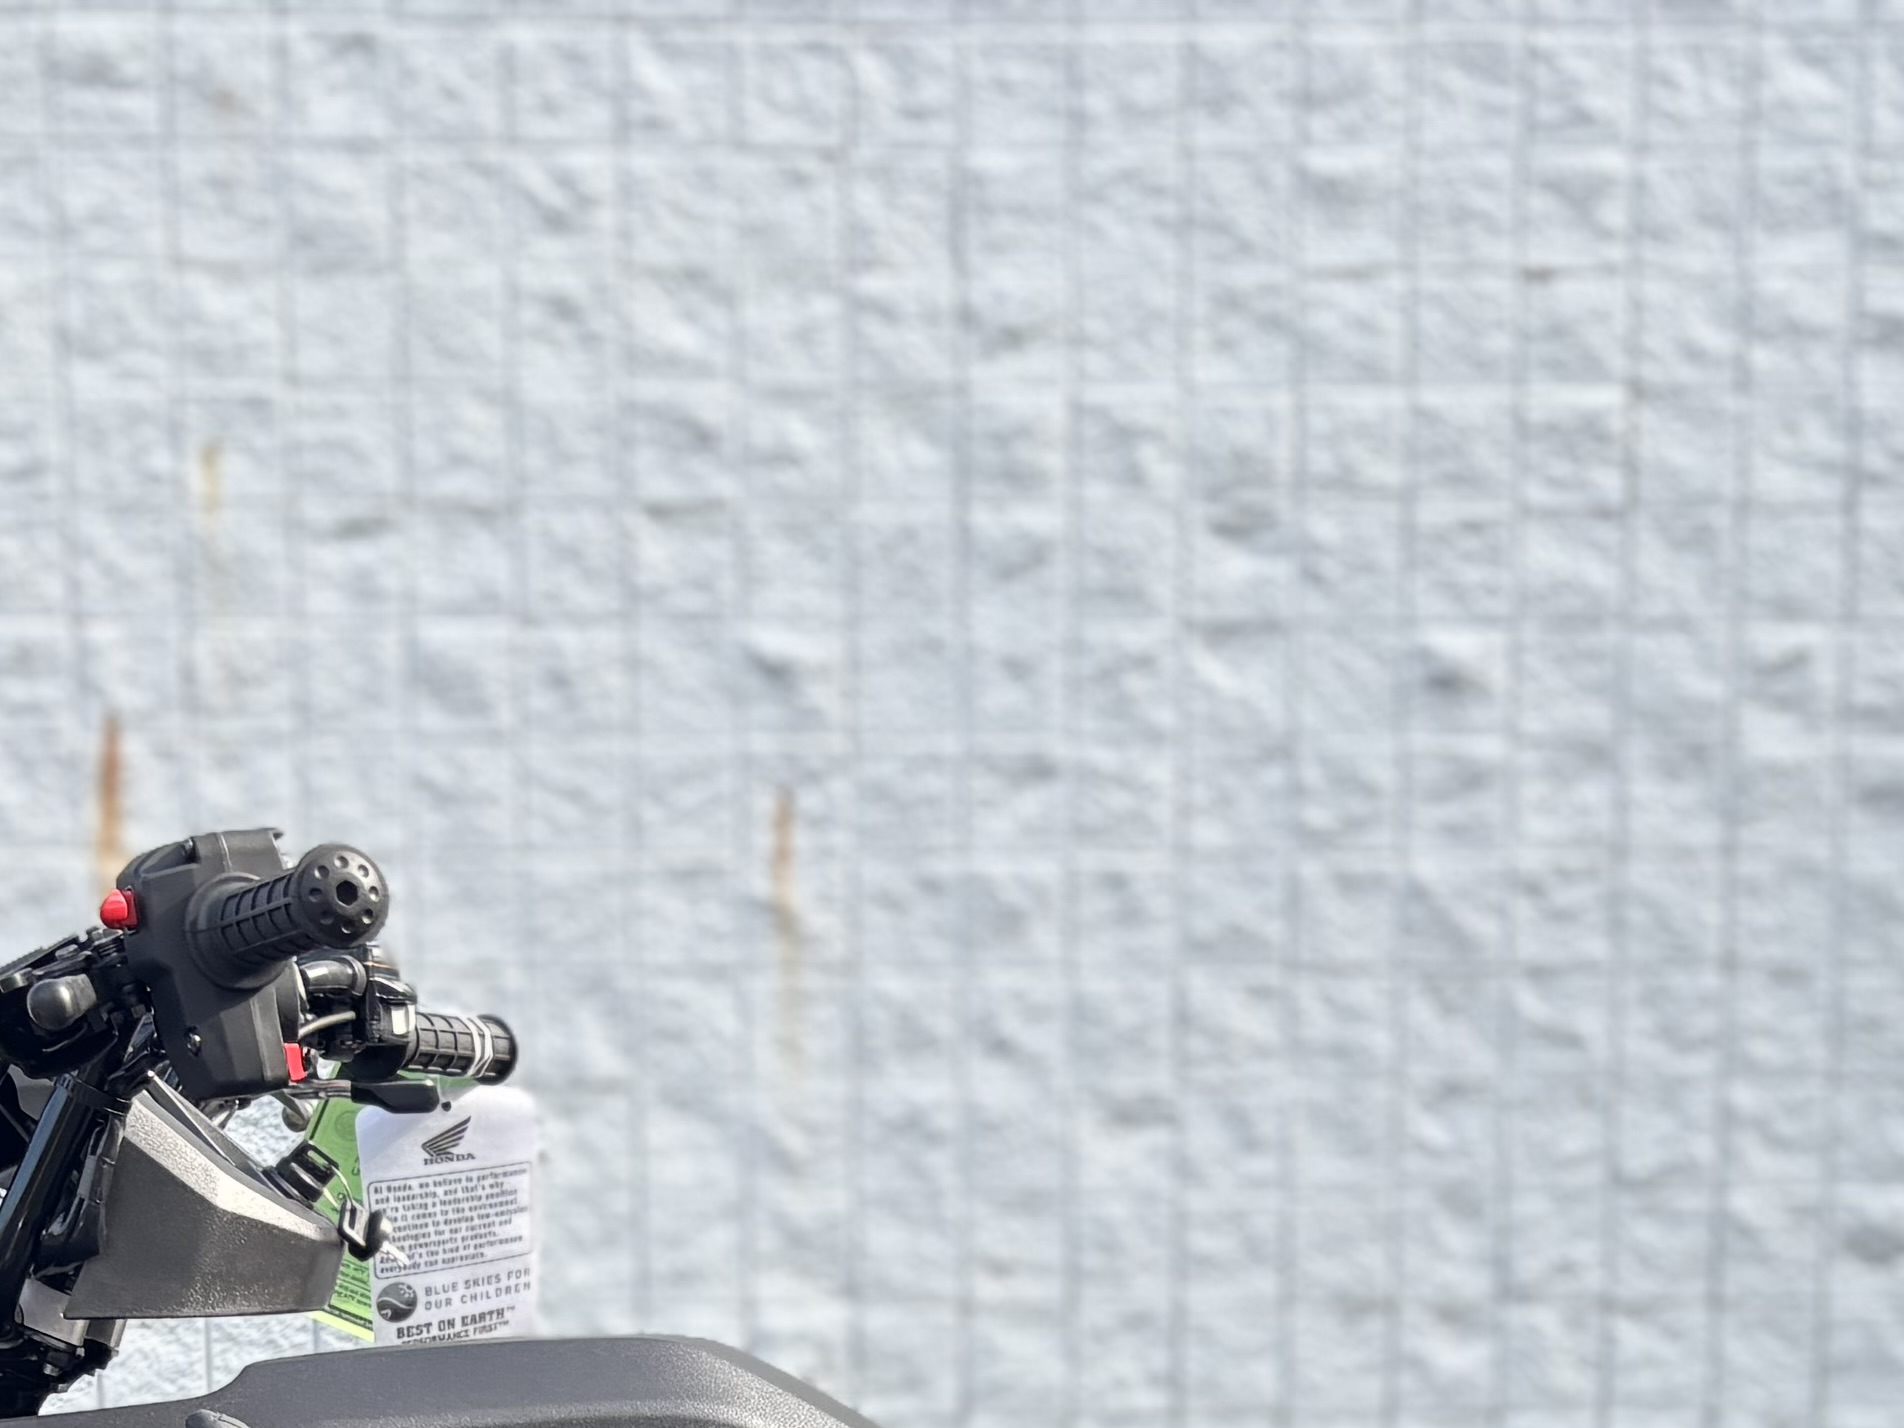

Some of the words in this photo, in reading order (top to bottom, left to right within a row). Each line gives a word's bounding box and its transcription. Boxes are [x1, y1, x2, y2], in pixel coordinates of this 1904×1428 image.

[424, 1152, 476, 1166] HONDA
[424, 1282, 459, 1297] BLUE
[464, 1273, 502, 1290] SKIES
[507, 1267, 530, 1282] FOR
[424, 1297, 453, 1311] OUR
[460, 1281, 531, 1304] CHILDREN
[396, 1322, 433, 1340] BEST
[437, 1317, 456, 1332] ON
